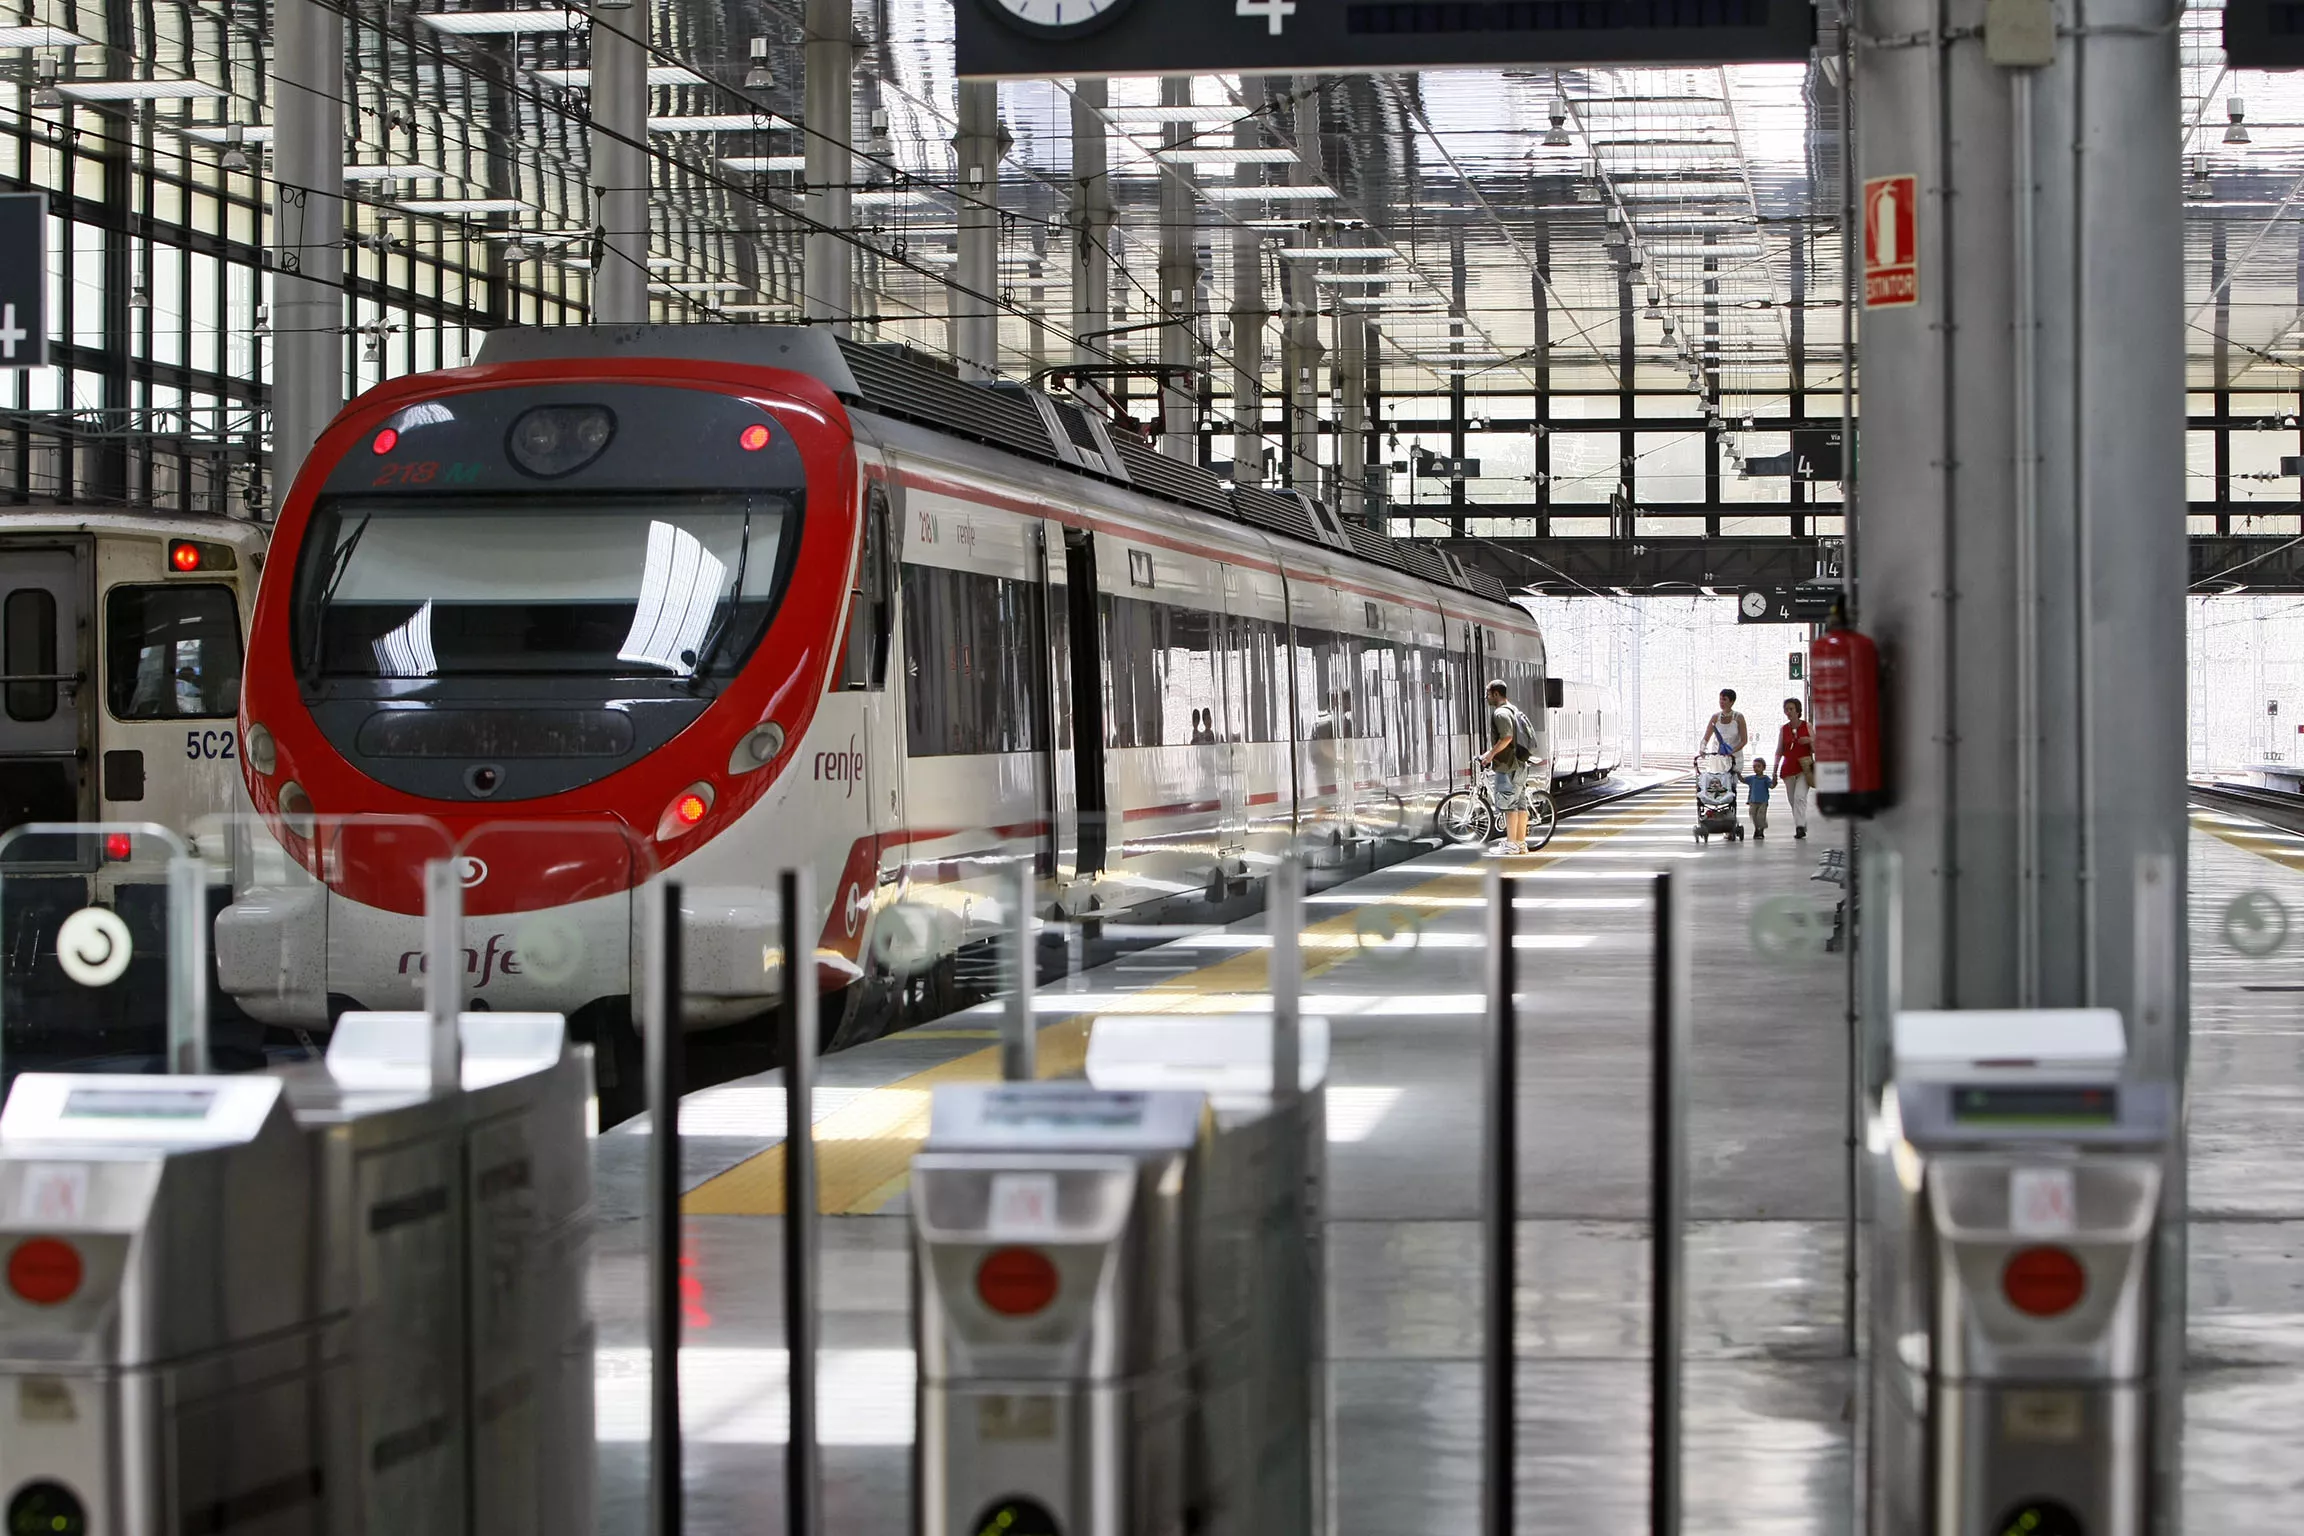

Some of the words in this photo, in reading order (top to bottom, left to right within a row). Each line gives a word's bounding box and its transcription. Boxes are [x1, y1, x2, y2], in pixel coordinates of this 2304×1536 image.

[372, 462, 439, 486] 218
[1797, 455, 1814, 478] 4
[956, 513, 976, 557] renfe
[1828, 562, 1839, 577] 4
[1780, 605, 1790, 619] 4
[186, 730, 235, 760] 5C2
[814, 733, 863, 799] renfe
[398, 933, 523, 989] rnfe
